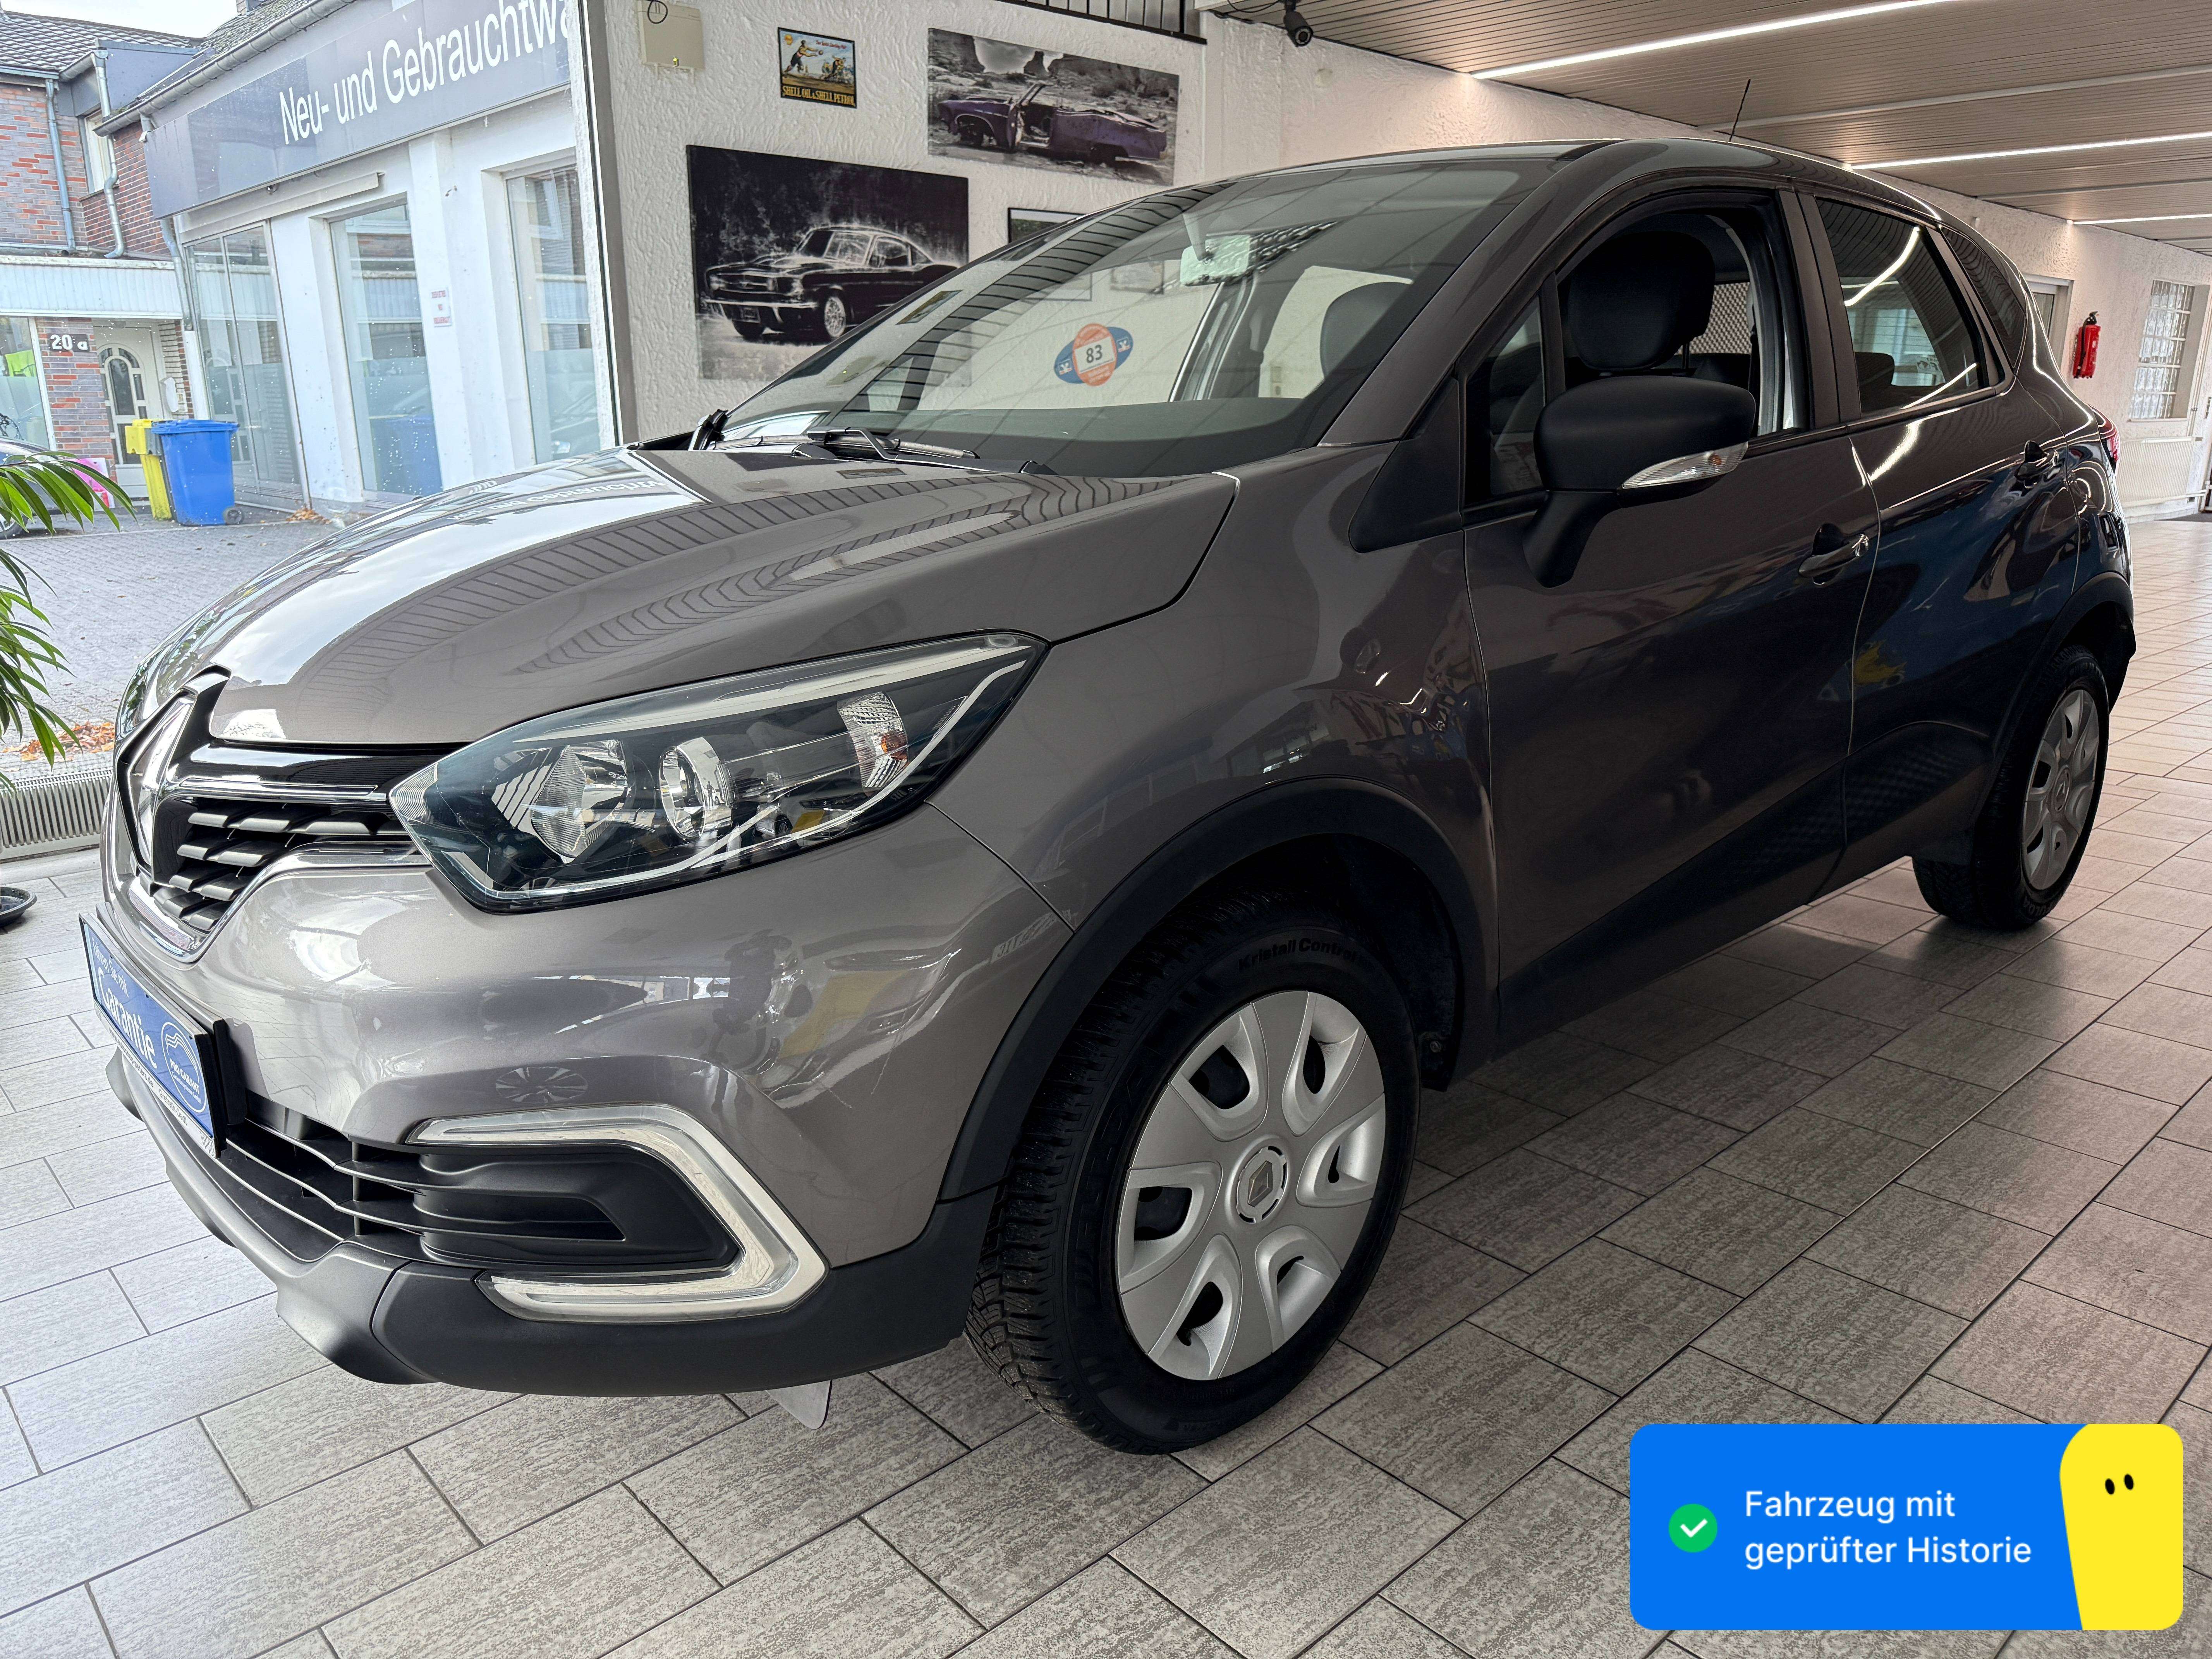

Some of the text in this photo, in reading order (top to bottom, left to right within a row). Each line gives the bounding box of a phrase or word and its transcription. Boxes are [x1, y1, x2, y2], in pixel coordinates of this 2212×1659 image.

[280, 87, 330, 145] Neu-
[334, 51, 377, 124] und
[782, 86, 801, 97] SHELL
[815, 90, 833, 102] SHELL
[50, 334, 88, 350] 20 a
[1086, 344, 1103, 364] 83
[92, 937, 129, 998] Fahren Sie mit
[1238, 938, 1357, 970] Kristall Control
[98, 967, 157, 1069] Garantie
[170, 1058, 200, 1094] PRO GARANT
